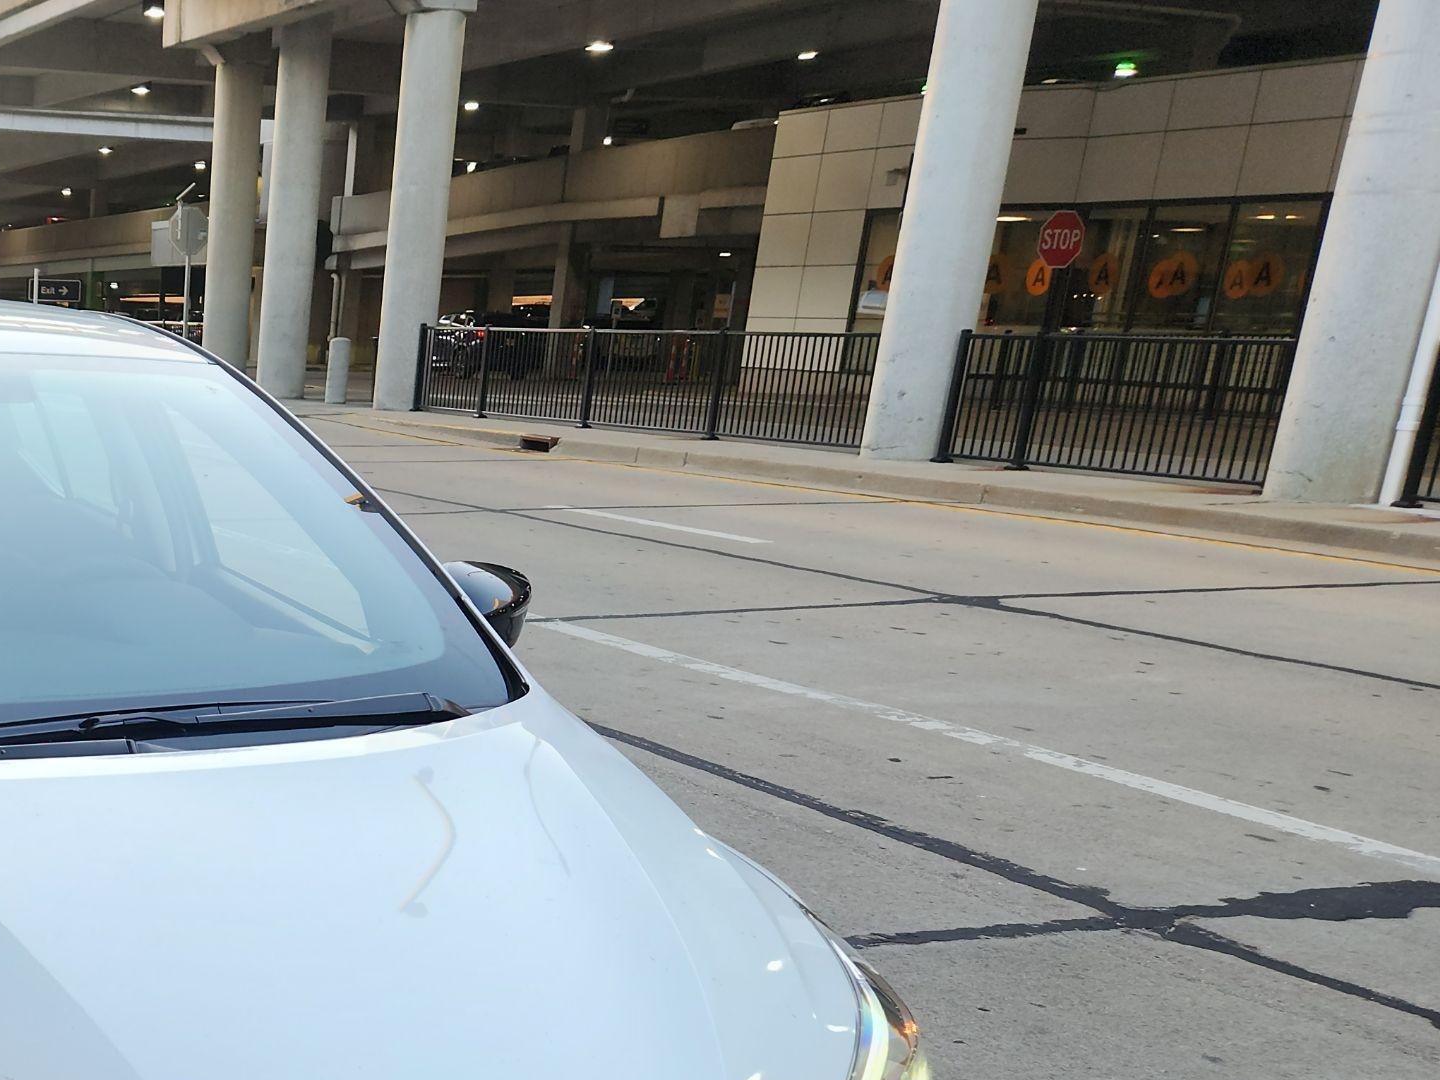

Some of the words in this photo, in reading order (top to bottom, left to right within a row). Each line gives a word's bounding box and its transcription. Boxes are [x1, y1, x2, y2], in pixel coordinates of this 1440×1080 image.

[1041, 228, 1082, 250] STOP
[1031, 266, 1046, 287] A
[1094, 262, 1110, 286] A
